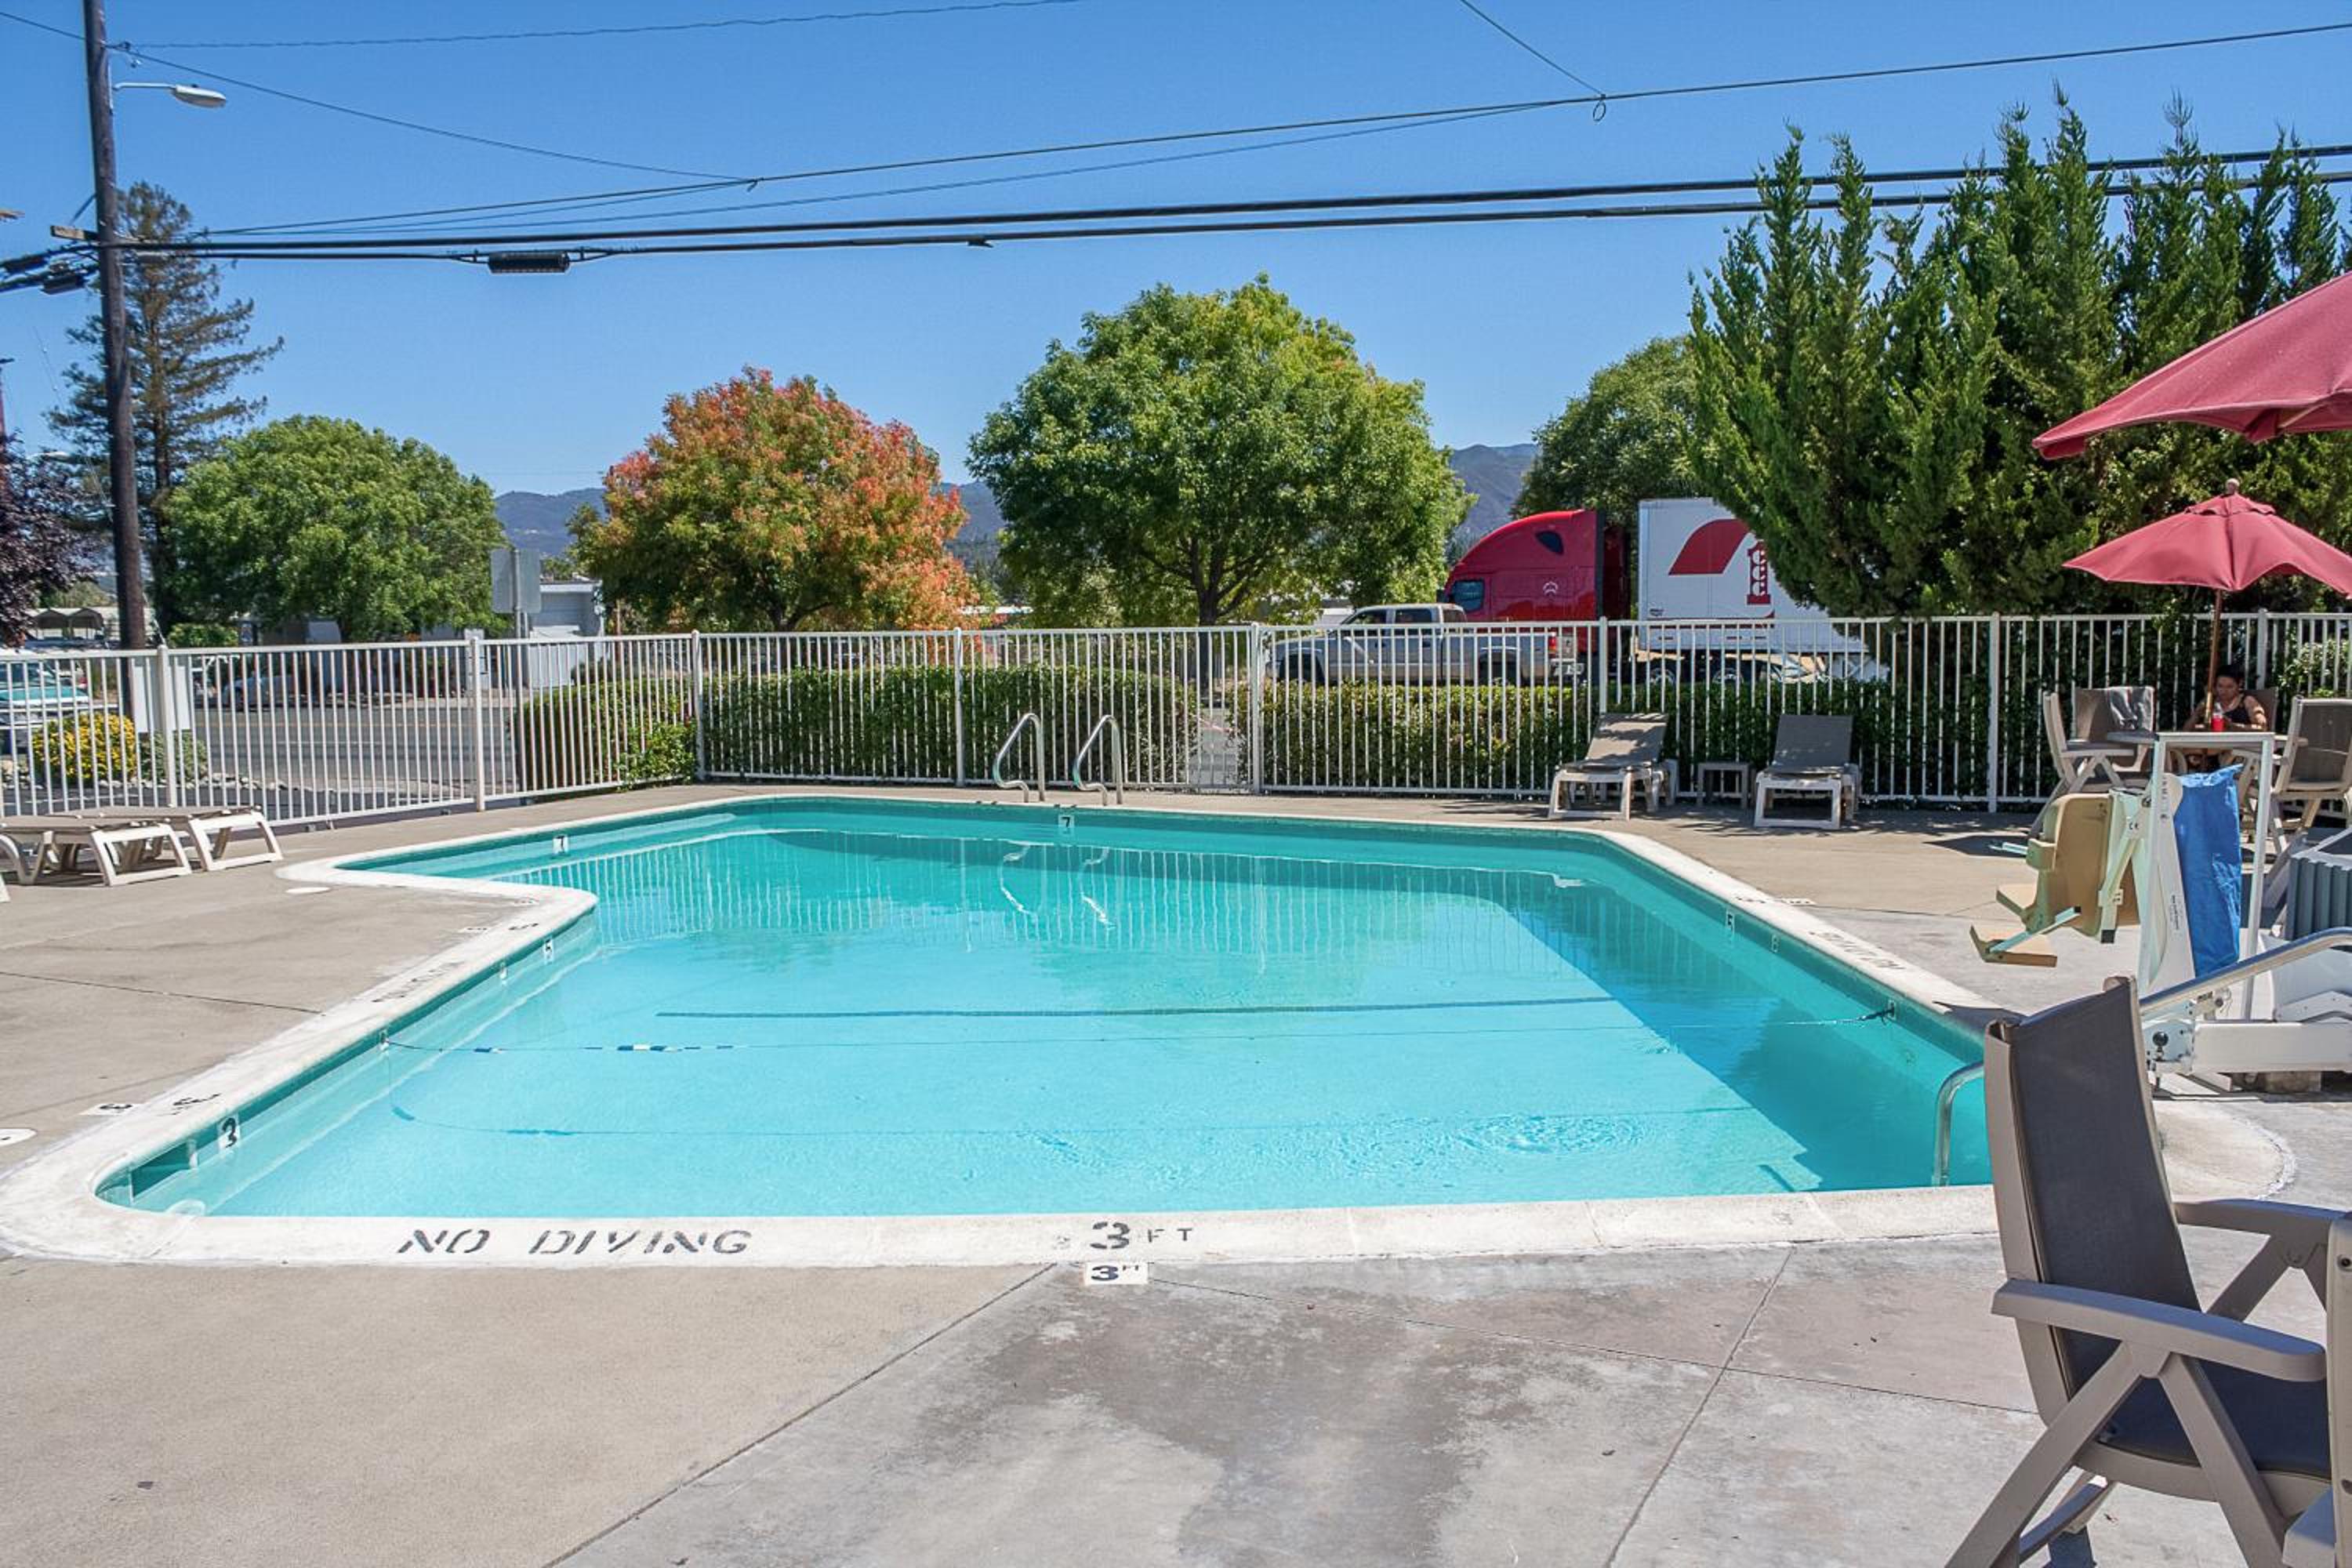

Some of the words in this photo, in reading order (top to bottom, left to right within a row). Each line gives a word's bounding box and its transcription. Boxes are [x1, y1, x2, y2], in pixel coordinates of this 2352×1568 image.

[1062, 816, 1071, 828] 7
[222, 1117, 237, 1148] 3
[397, 1229, 492, 1254] NO
[528, 1229, 754, 1254] DIVING
[1089, 1221, 1131, 1250] 3
[1147, 1227, 1192, 1243] FT
[1091, 1265, 1119, 1282] 3
